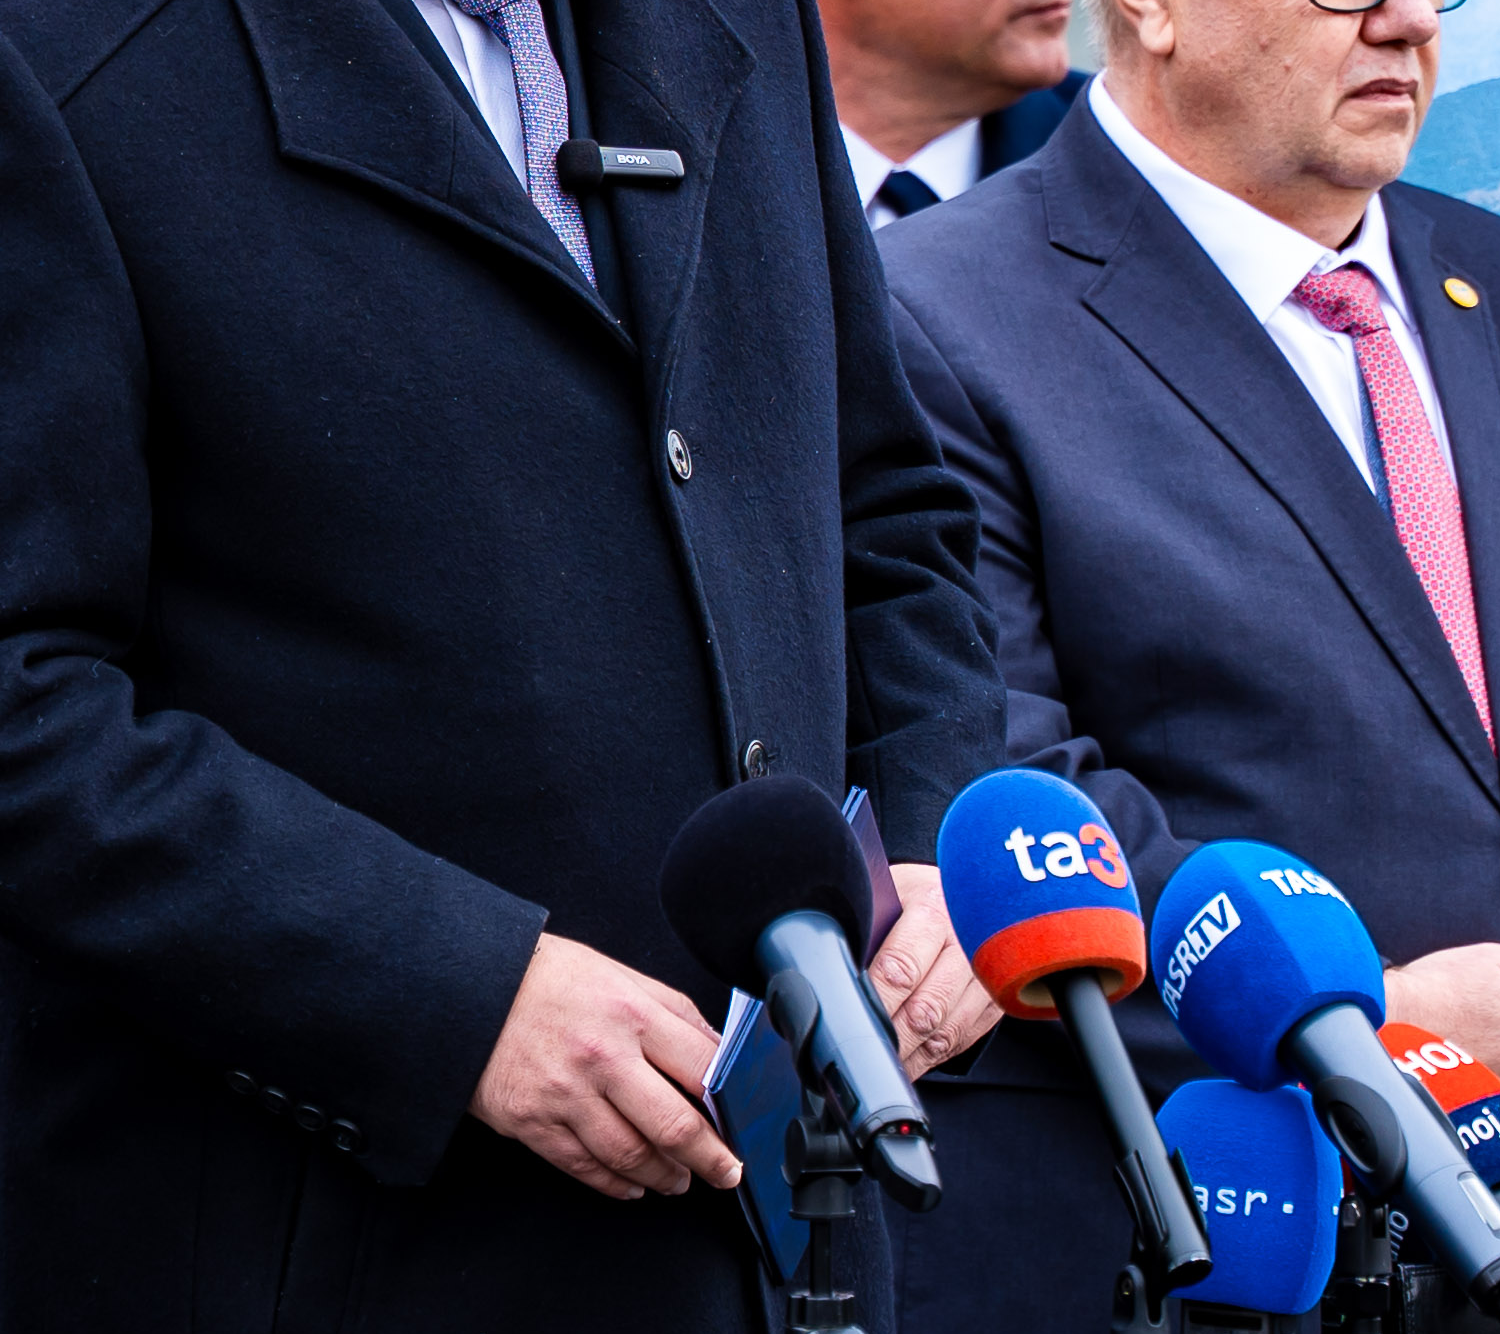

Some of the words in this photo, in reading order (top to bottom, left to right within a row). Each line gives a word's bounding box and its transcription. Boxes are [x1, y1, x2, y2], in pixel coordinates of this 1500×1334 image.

[616, 154, 650, 165] BOYA
[1004, 825, 1128, 889] ta3
[1259, 869, 1354, 913] TAS
[1393, 1041, 1474, 1081] HOJ
